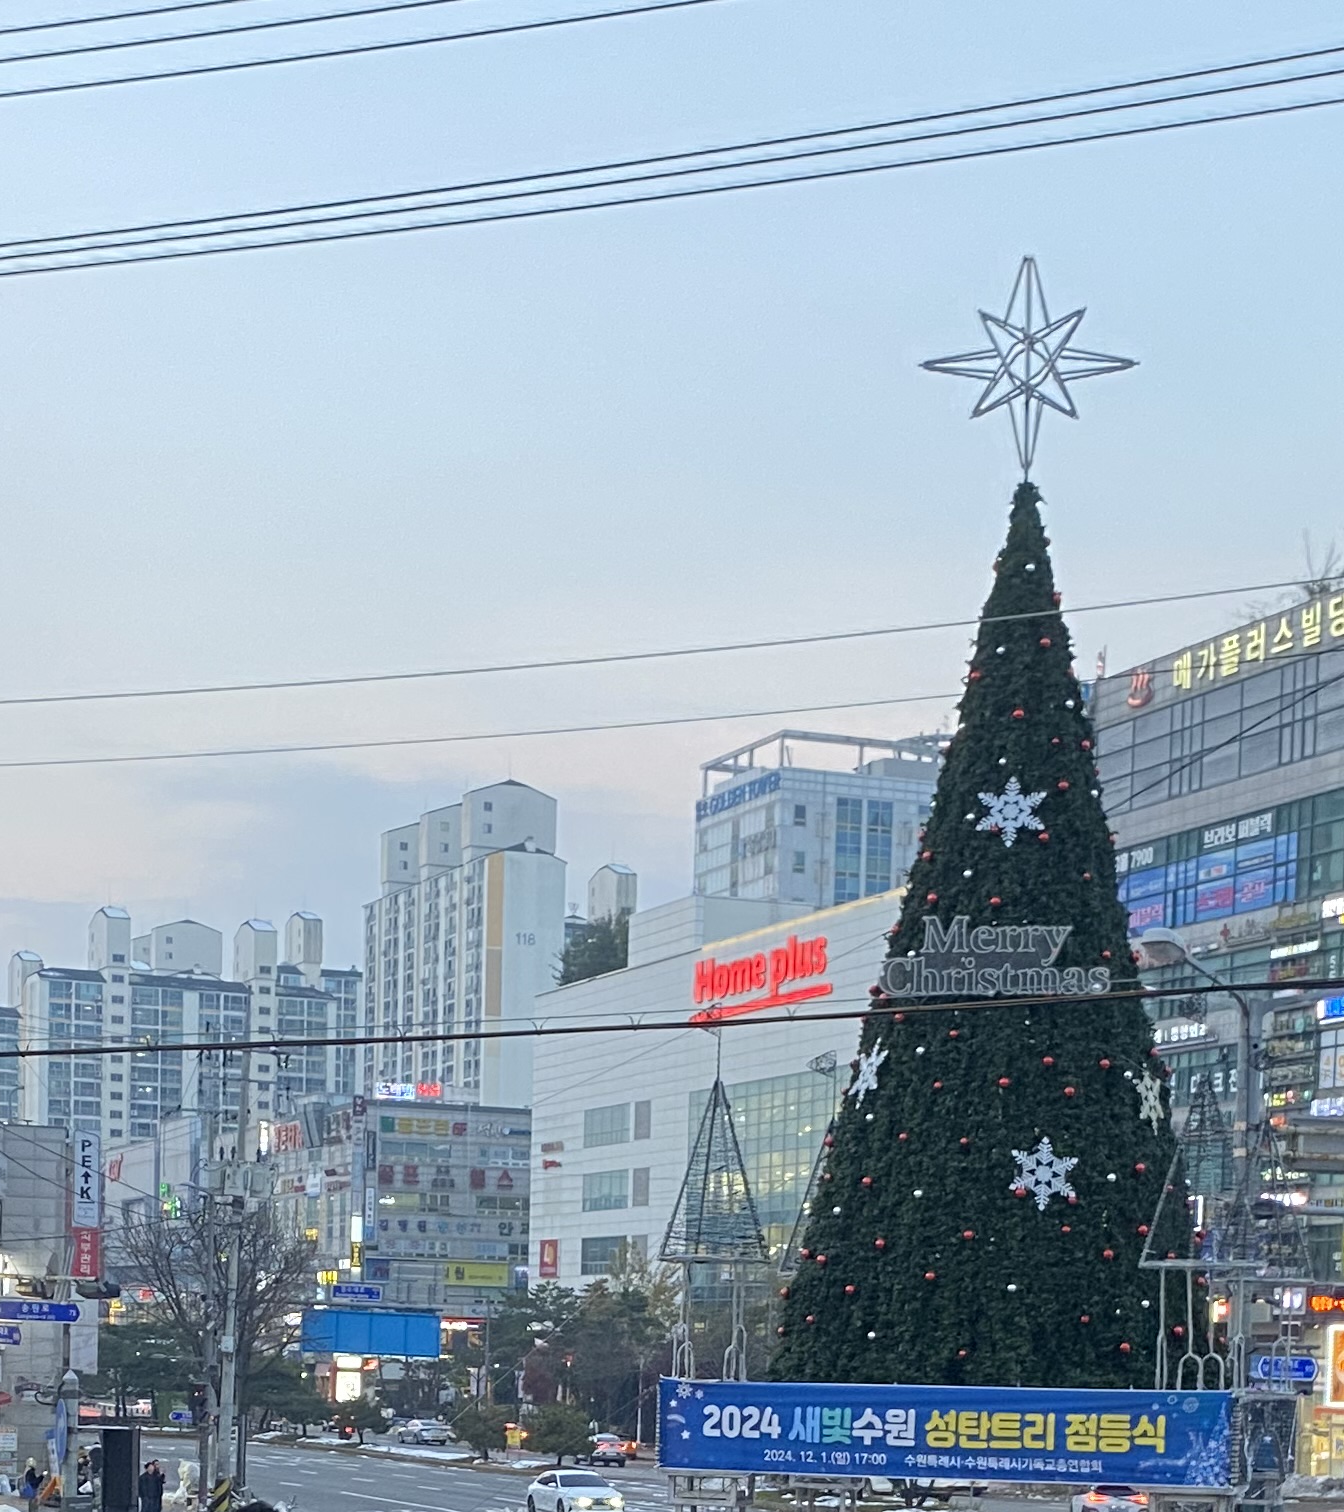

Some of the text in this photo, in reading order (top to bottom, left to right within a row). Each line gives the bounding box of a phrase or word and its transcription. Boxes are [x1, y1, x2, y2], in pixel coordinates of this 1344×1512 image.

[515, 931, 536, 946] 118
[919, 914, 1074, 967] Merry
[692, 933, 828, 1004] Home plus
[878, 957, 1112, 996] Christmas
[702, 1404, 1167, 1454] 2024 새빛수원 성탄트리 점등식
[763, 1449, 796, 1463] 2024.
[800, 1451, 817, 1463] 12.
[853, 1452, 888, 1466] 17:00
